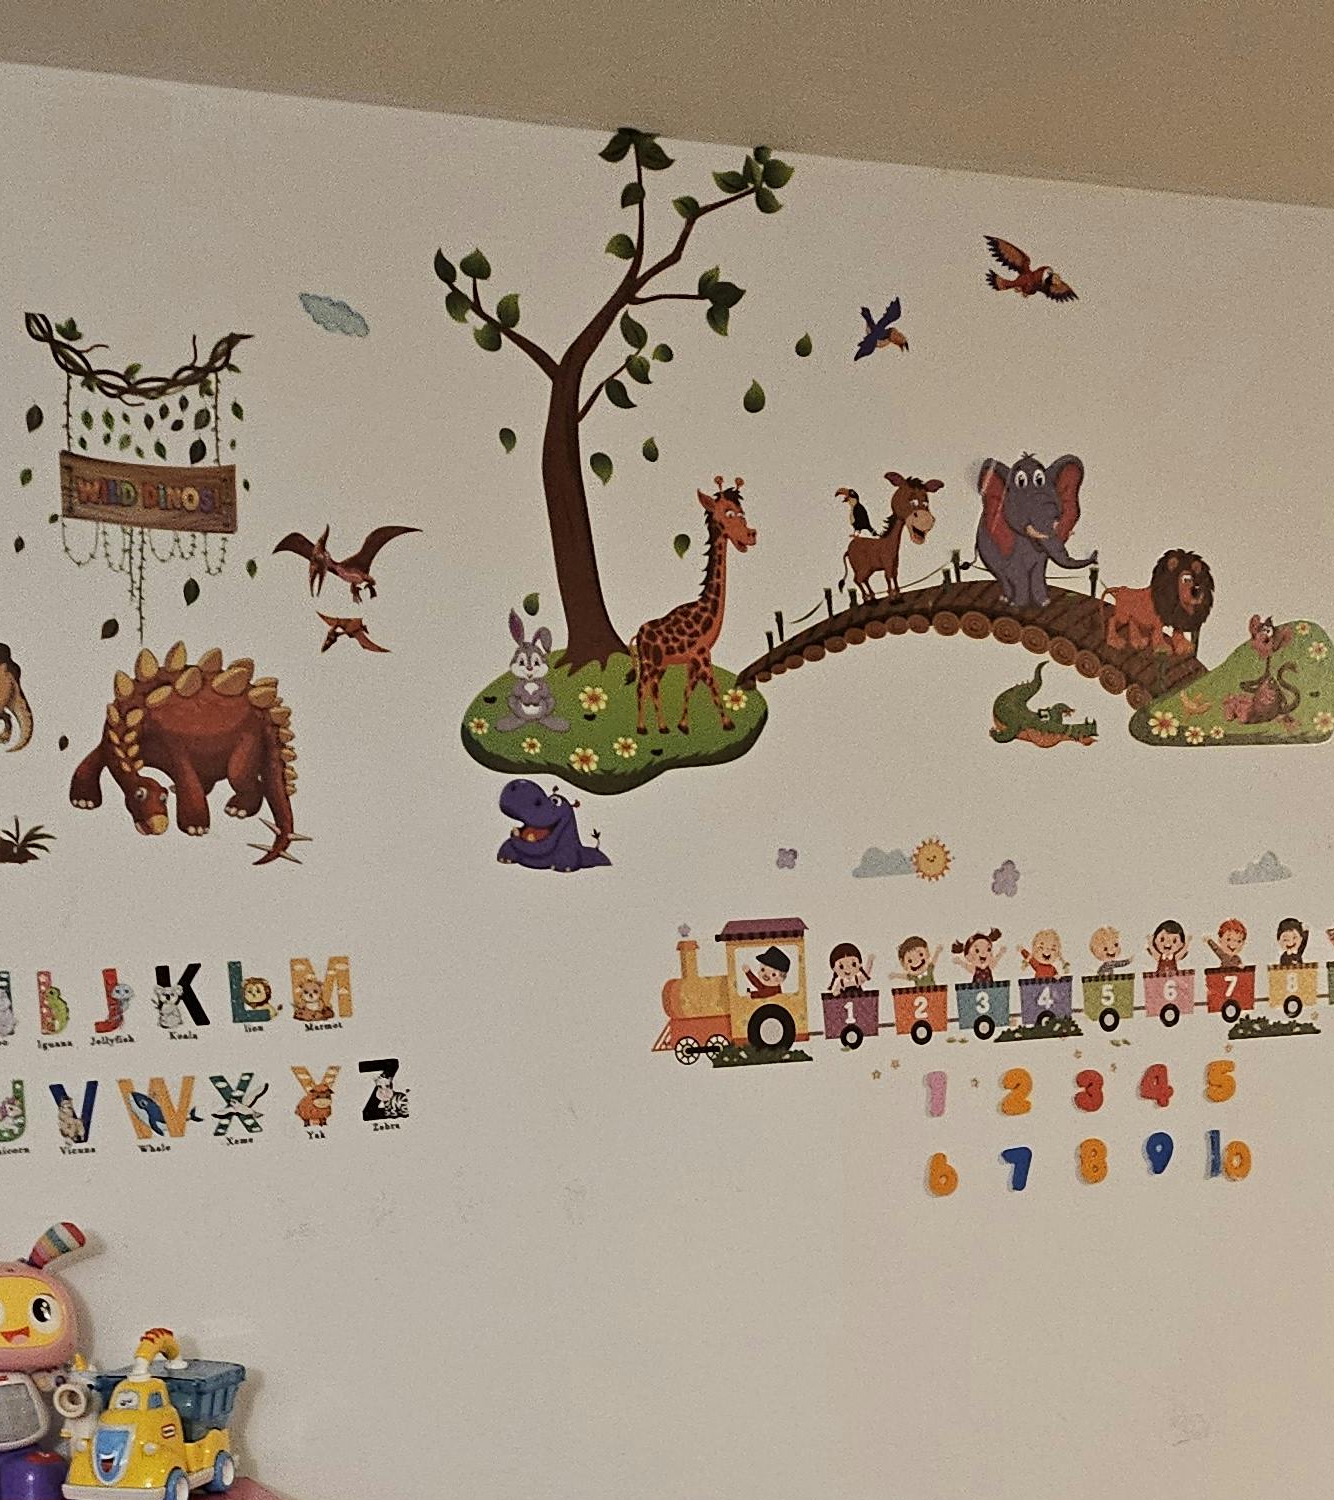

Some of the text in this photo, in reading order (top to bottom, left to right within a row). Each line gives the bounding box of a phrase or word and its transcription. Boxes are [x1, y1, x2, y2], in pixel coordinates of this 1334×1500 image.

[37, 971, 57, 1035] I
[94, 968, 124, 1033] J
[151, 963, 210, 1029] K
[227, 961, 271, 1023] L
[290, 956, 353, 1021] M
[843, 1002, 855, 1024] 1
[914, 996, 928, 1018] 2
[976, 992, 990, 1013] 3
[1037, 987, 1054, 1010] 4
[1101, 984, 1115, 1006] 5
[1163, 980, 1177, 1001] 6
[1224, 976, 1239, 997] 7
[1287, 973, 1298, 993] 8
[37, 1039, 73, 1050] Iguana
[90, 1035, 135, 1047] Jellyfish
[169, 1031, 199, 1041] Koala
[304, 1022, 343, 1031] Marmot
[49, 1081, 98, 1143] V
[117, 1076, 195, 1139] W
[209, 1073, 263, 1136] X
[291, 1065, 341, 1126] Y
[359, 1059, 399, 1121] Z
[925, 1060, 1236, 1117] 1 2 3 4 5
[139, 1144, 171, 1153] Whale
[307, 1131, 326, 1141] Yak
[372, 1122, 401, 1132] Zebra
[927, 1153, 958, 1196] 6
[1001, 1147, 1032, 1191] 7
[1079, 1138, 1108, 1184] 8
[1146, 1132, 1174, 1174] 9
